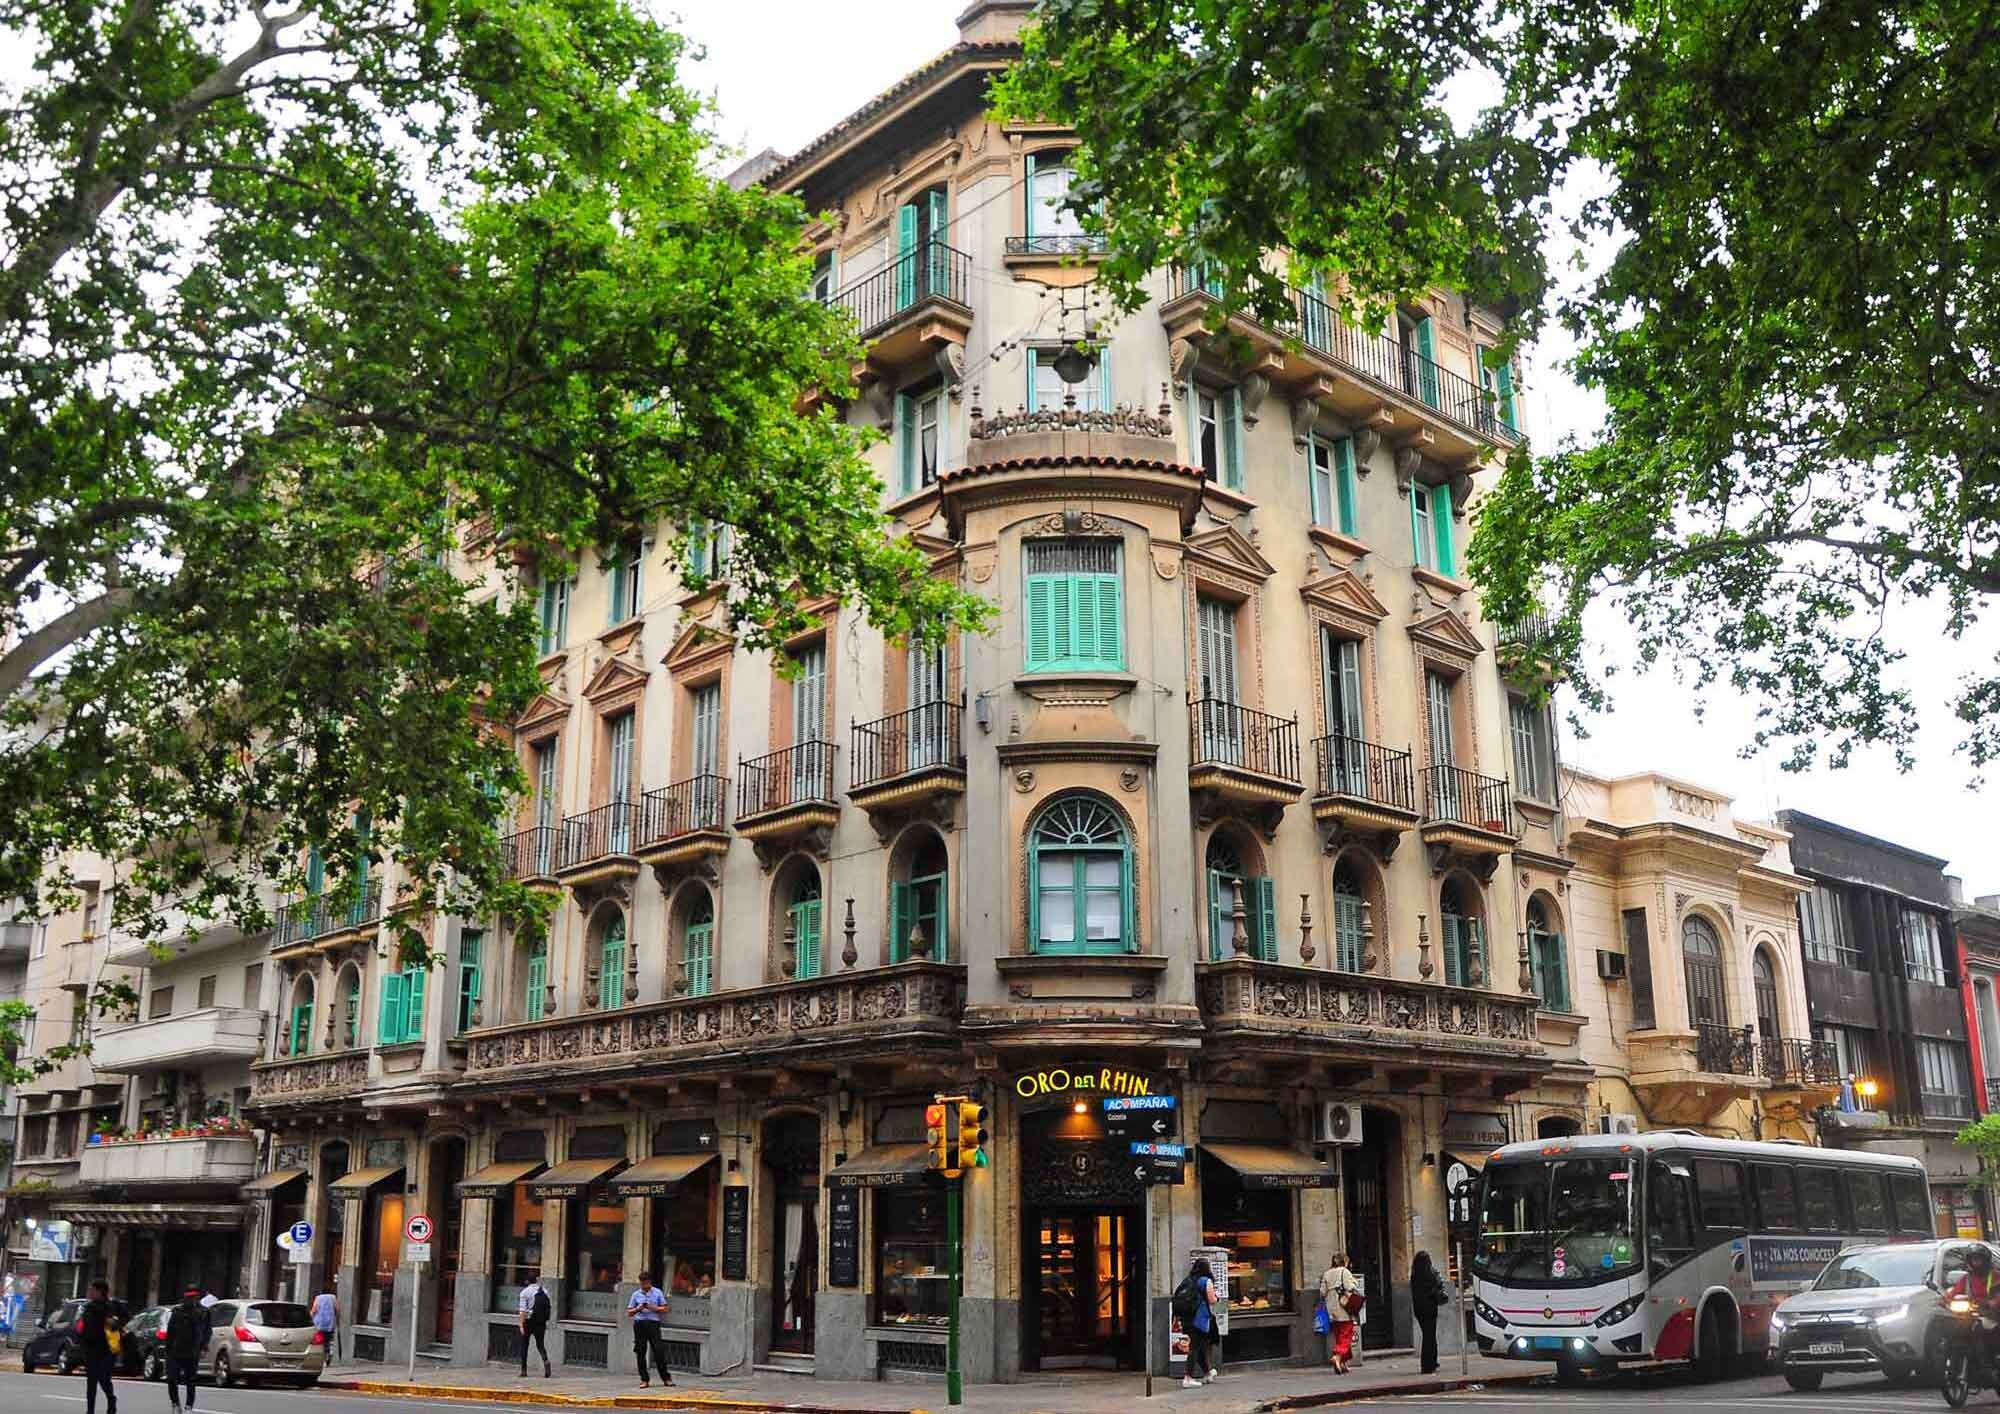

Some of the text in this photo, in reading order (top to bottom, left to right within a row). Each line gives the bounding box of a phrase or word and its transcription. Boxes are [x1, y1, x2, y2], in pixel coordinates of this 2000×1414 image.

[1016, 1068, 1149, 1097] ORO DEL RHIN
[840, 1176, 856, 1186] ORO
[867, 1175, 884, 1185] RHIN
[296, 1224, 307, 1239] E
